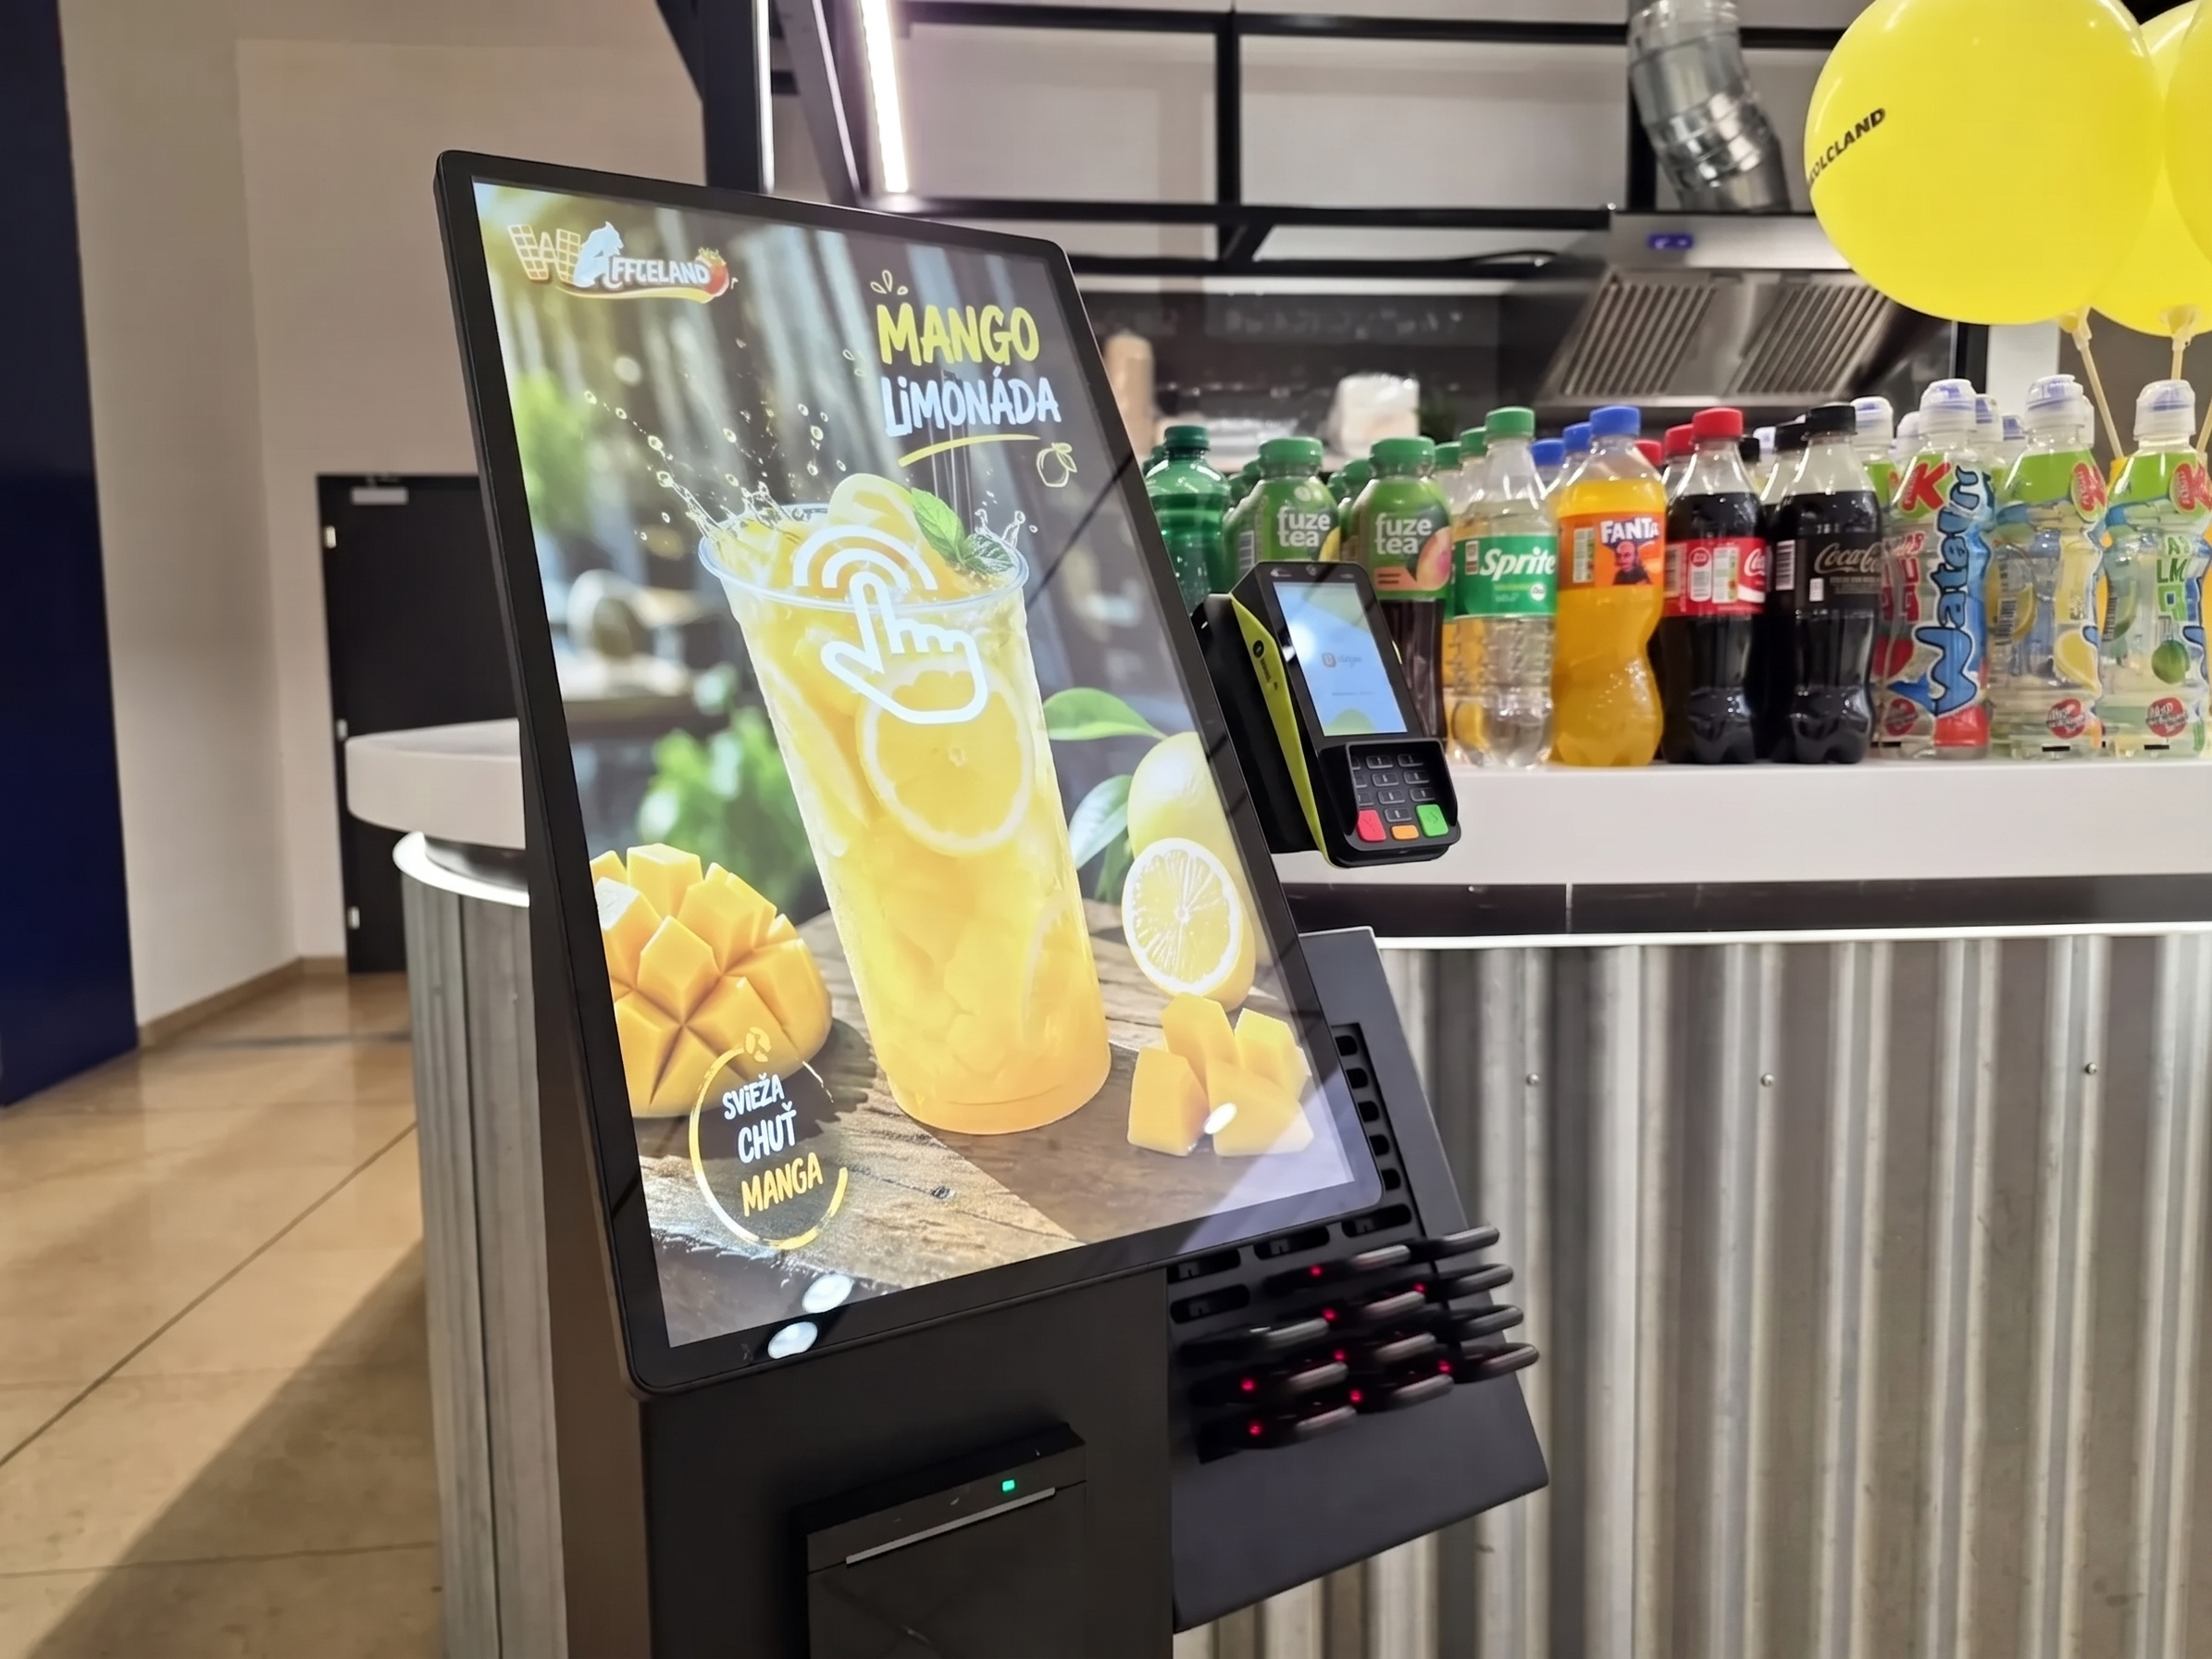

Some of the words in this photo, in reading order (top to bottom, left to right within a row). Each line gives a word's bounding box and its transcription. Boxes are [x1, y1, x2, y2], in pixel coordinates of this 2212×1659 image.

[876, 302, 1039, 366] MANGO
[1277, 505, 1331, 531] fuze
[1375, 512, 1433, 538] fuze
[1600, 517, 1659, 544] FANTA
[1277, 527, 1320, 548] tea
[1374, 534, 1419, 555] tea
[1479, 546, 1557, 581] Sprite
[738, 1101, 797, 1164] CHUŤ
[741, 1152, 824, 1217] MANGA
